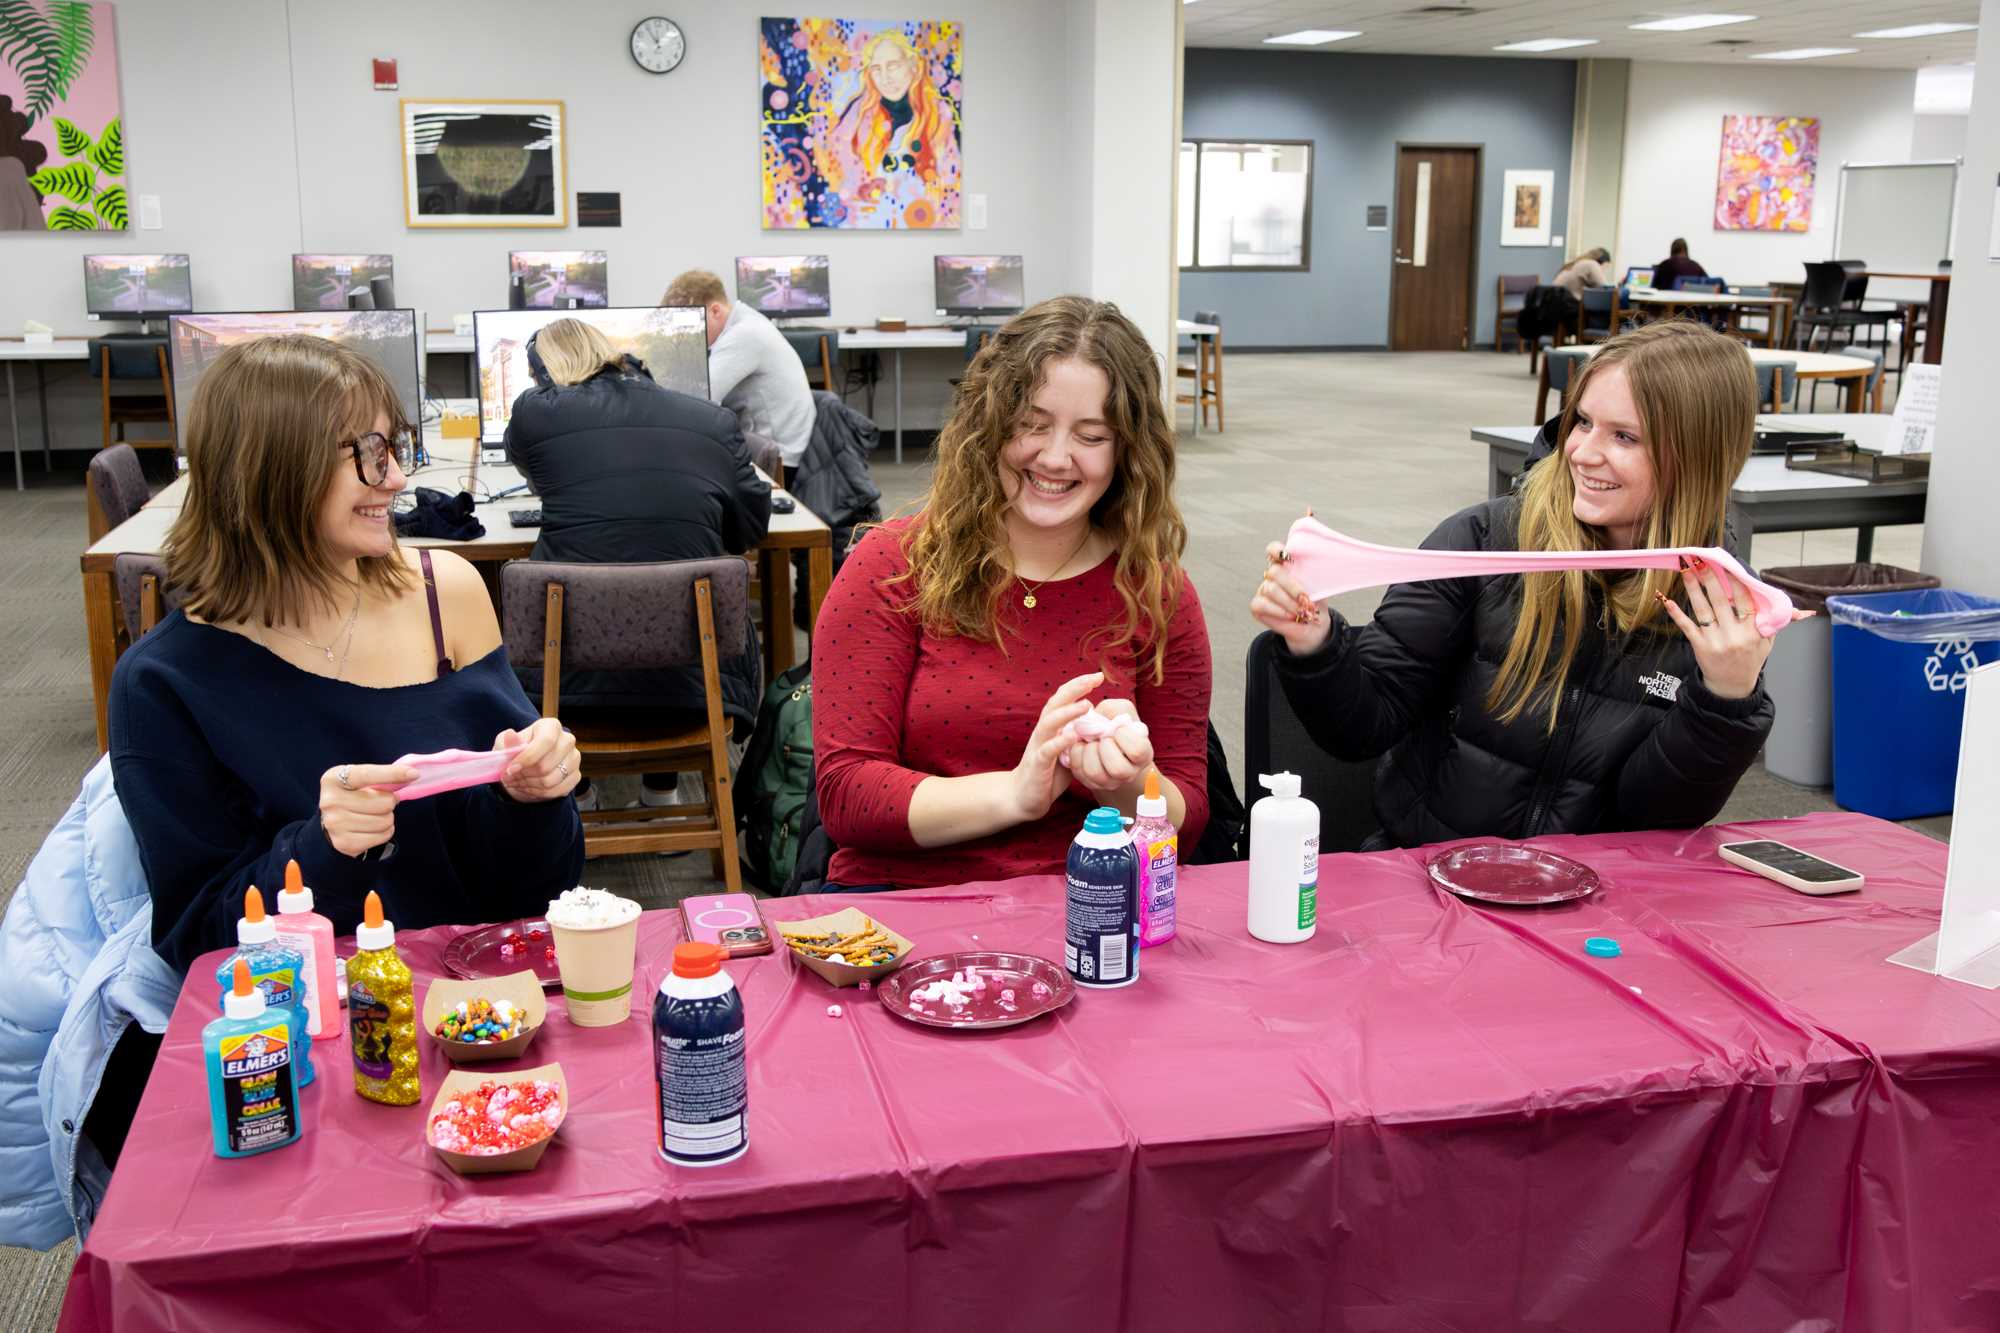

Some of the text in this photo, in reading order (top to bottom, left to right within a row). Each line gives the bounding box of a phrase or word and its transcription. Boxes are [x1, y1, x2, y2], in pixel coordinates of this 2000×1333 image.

[1638, 675, 1670, 691] NORTH
[1656, 671, 1674, 684] THE
[1645, 685, 1669, 699] FACE
[696, 1036, 722, 1046] SHAVE
[227, 1048, 288, 1074] ELMER'S
[240, 1070, 277, 1089] GLOW
[243, 1087, 275, 1103] GLUE
